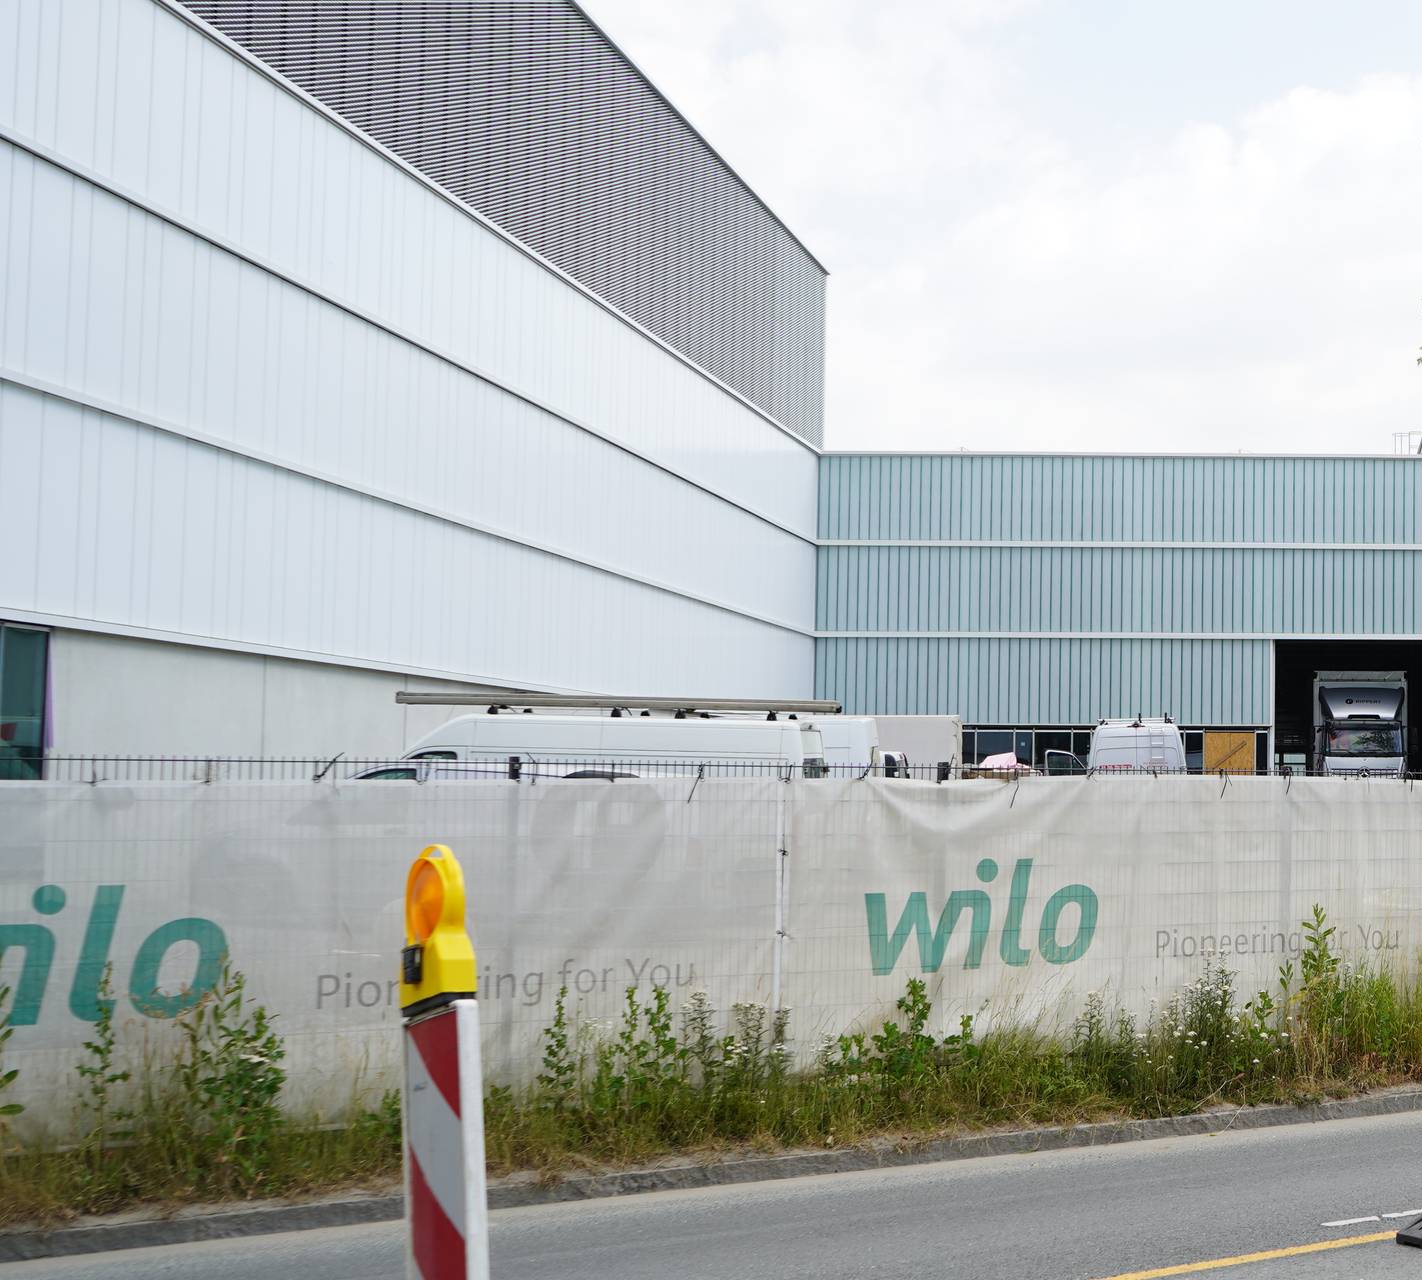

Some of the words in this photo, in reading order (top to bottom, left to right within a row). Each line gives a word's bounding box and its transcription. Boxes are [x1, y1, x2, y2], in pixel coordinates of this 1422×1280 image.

[0, 884, 229, 1027] ilo
[864, 858, 1099, 976] wilo
[1156, 926, 1301, 960] Pioneering
[1311, 924, 1348, 951] or
[1357, 924, 1400, 951] You
[315, 967, 544, 1010] Pioning
[557, 958, 614, 994] for
[624, 957, 694, 989] You
